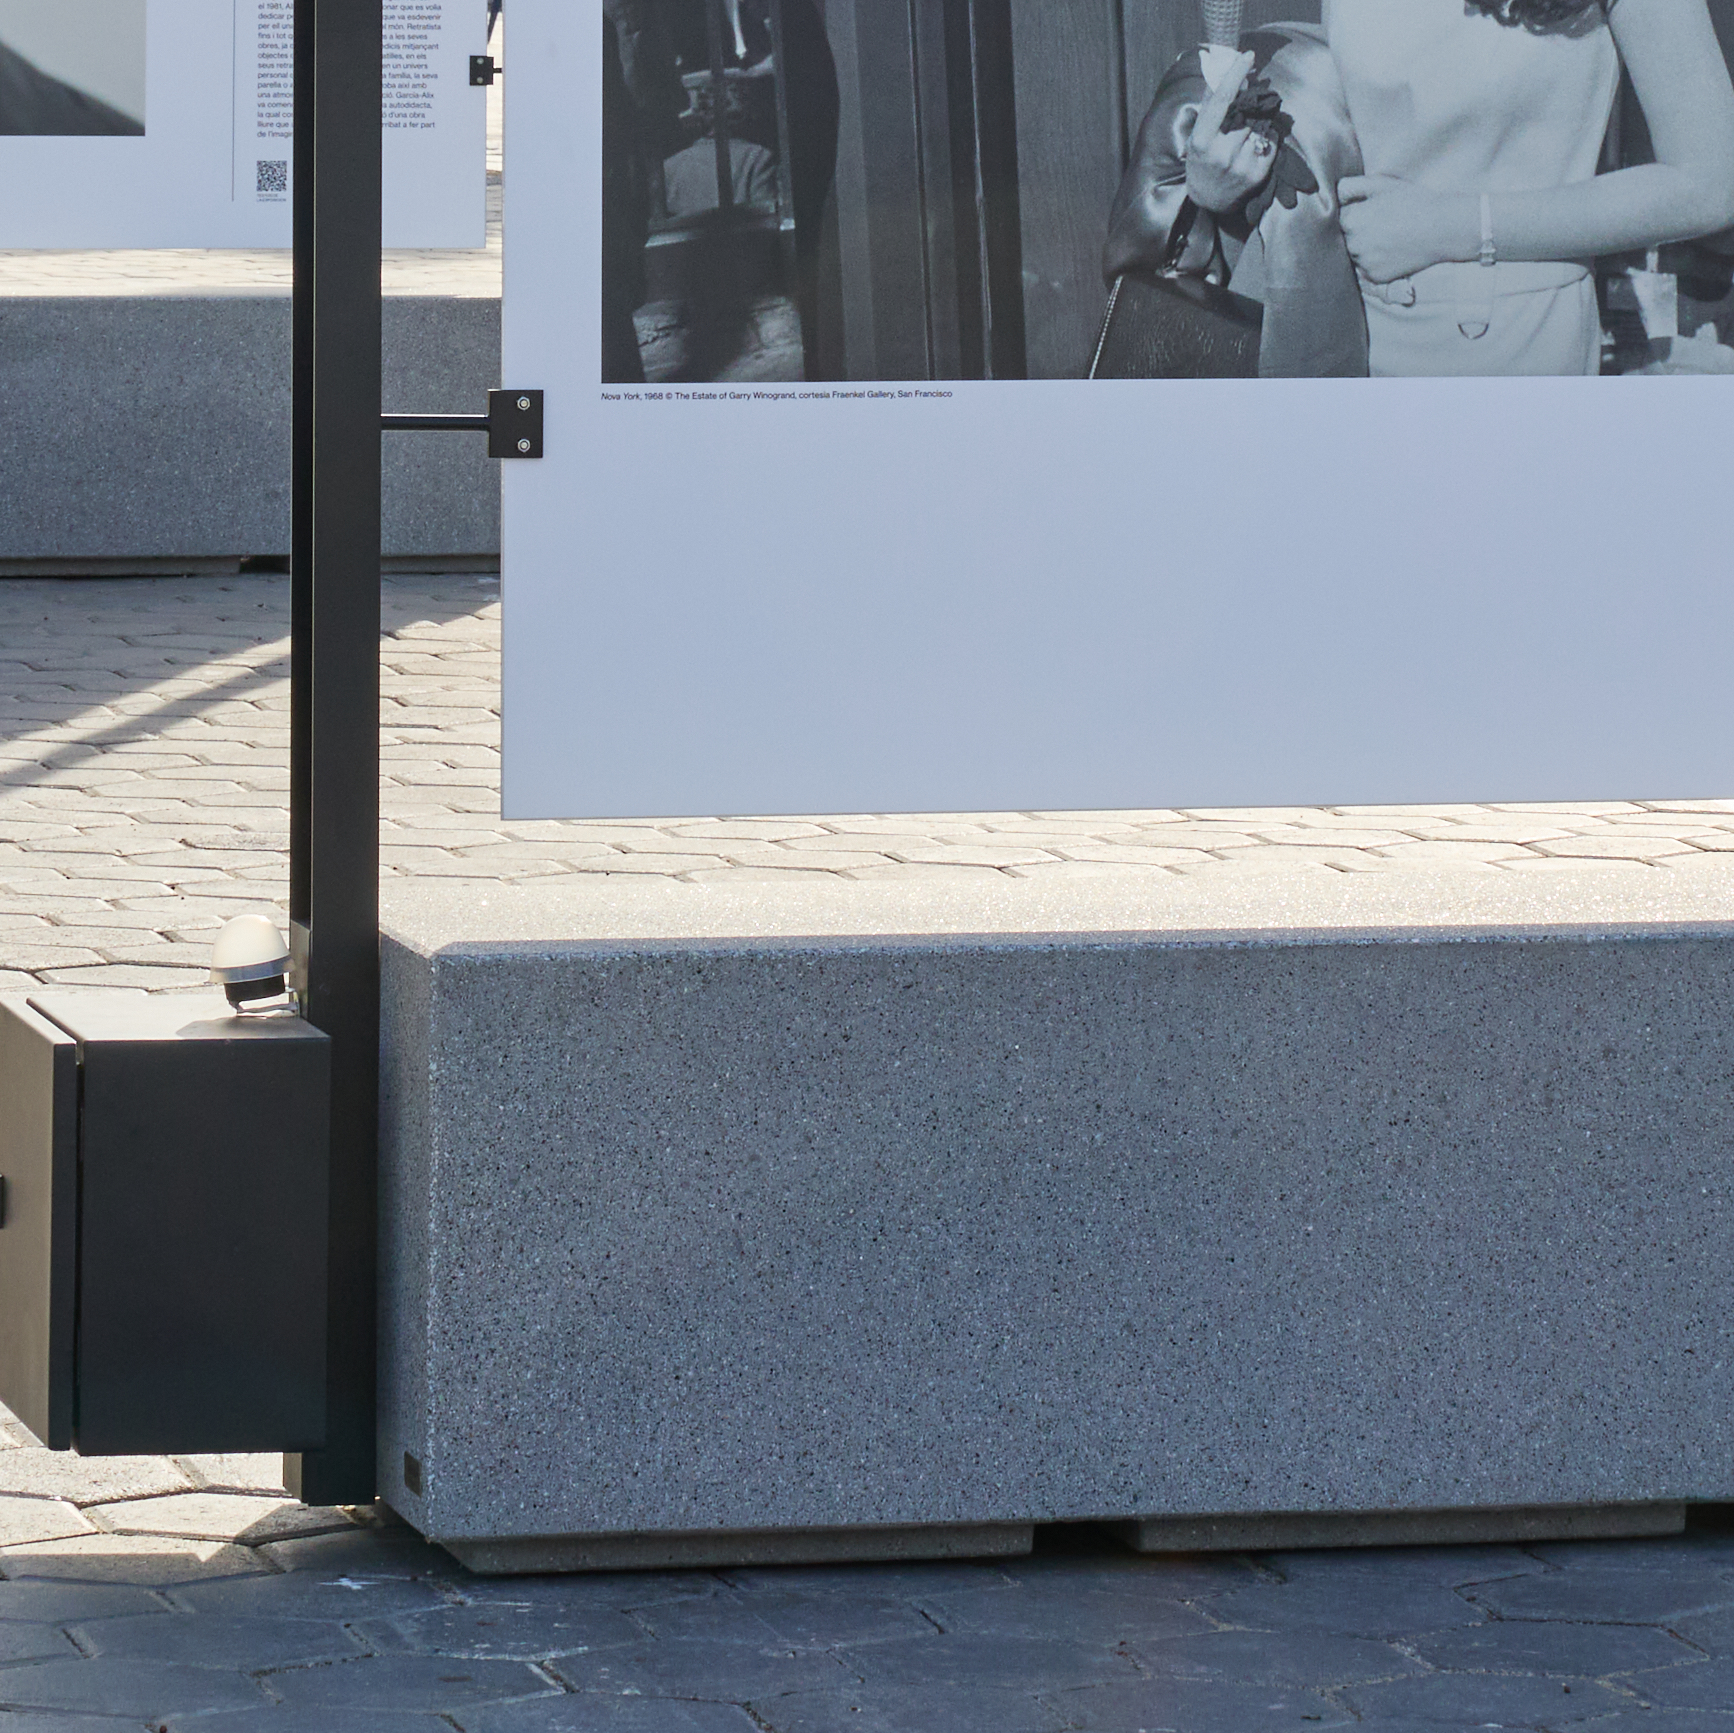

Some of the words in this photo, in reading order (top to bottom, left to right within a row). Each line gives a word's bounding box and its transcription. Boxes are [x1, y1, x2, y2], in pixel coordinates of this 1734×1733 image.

[624, 392, 642, 401] York,
[644, 392, 663, 400] 1968
[675, 392, 690, 400] The
[692, 392, 717, 400] Estate
[729, 392, 751, 401] Garry
[753, 392, 797, 400] Winogrand,
[867, 390, 896, 399] Gallery,
[898, 390, 913, 398] San
